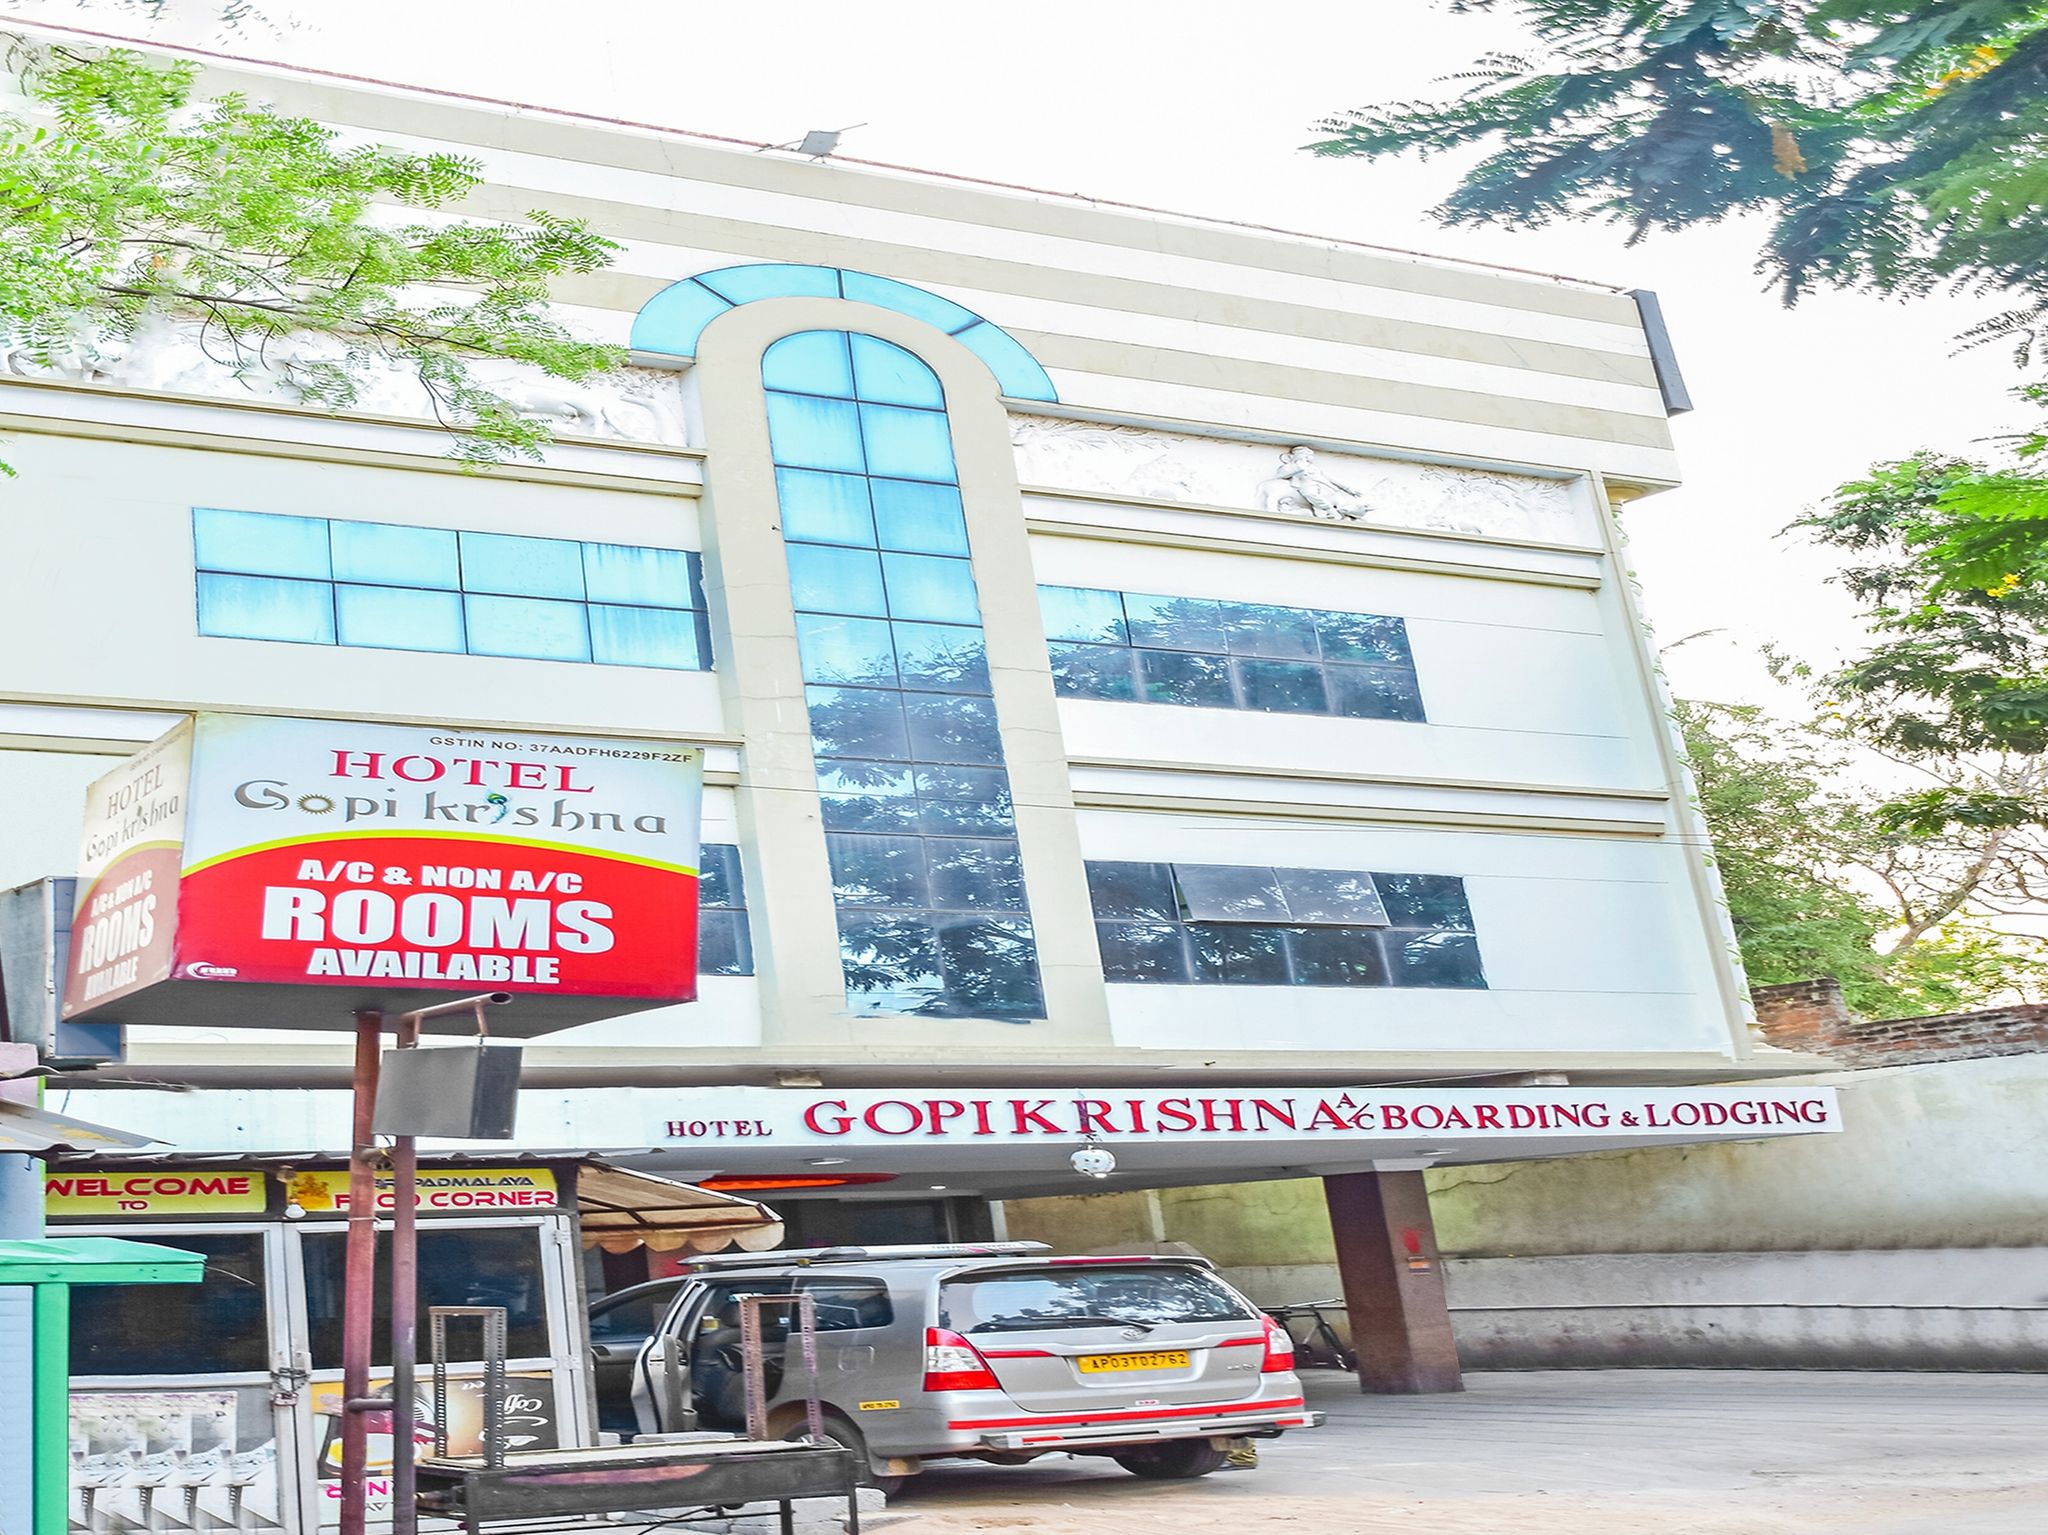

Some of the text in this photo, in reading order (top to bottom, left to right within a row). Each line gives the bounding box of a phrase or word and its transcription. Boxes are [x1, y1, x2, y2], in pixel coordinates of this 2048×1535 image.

[429, 736, 693, 763] GSTIN NO: 37AADFH6229F2ZF
[328, 749, 595, 793] HOTEL
[106, 764, 162, 820] HOTEL
[234, 779, 667, 834] Gopi krishna
[297, 859, 584, 893] A/C & NON A/C
[78, 893, 156, 974] ROOMS
[262, 886, 615, 953] ROOMS
[306, 948, 560, 984] AVAILABLE
[666, 1120, 773, 1137] HOTEL
[1379, 1103, 1611, 1130] BOARDING
[1620, 1110, 1640, 1127] &
[1644, 1099, 1828, 1127] LODGING
[45, 1177, 250, 1197] WELCOME
[117, 1200, 148, 1210] TO
[430, 1190, 555, 1207] CORNER
